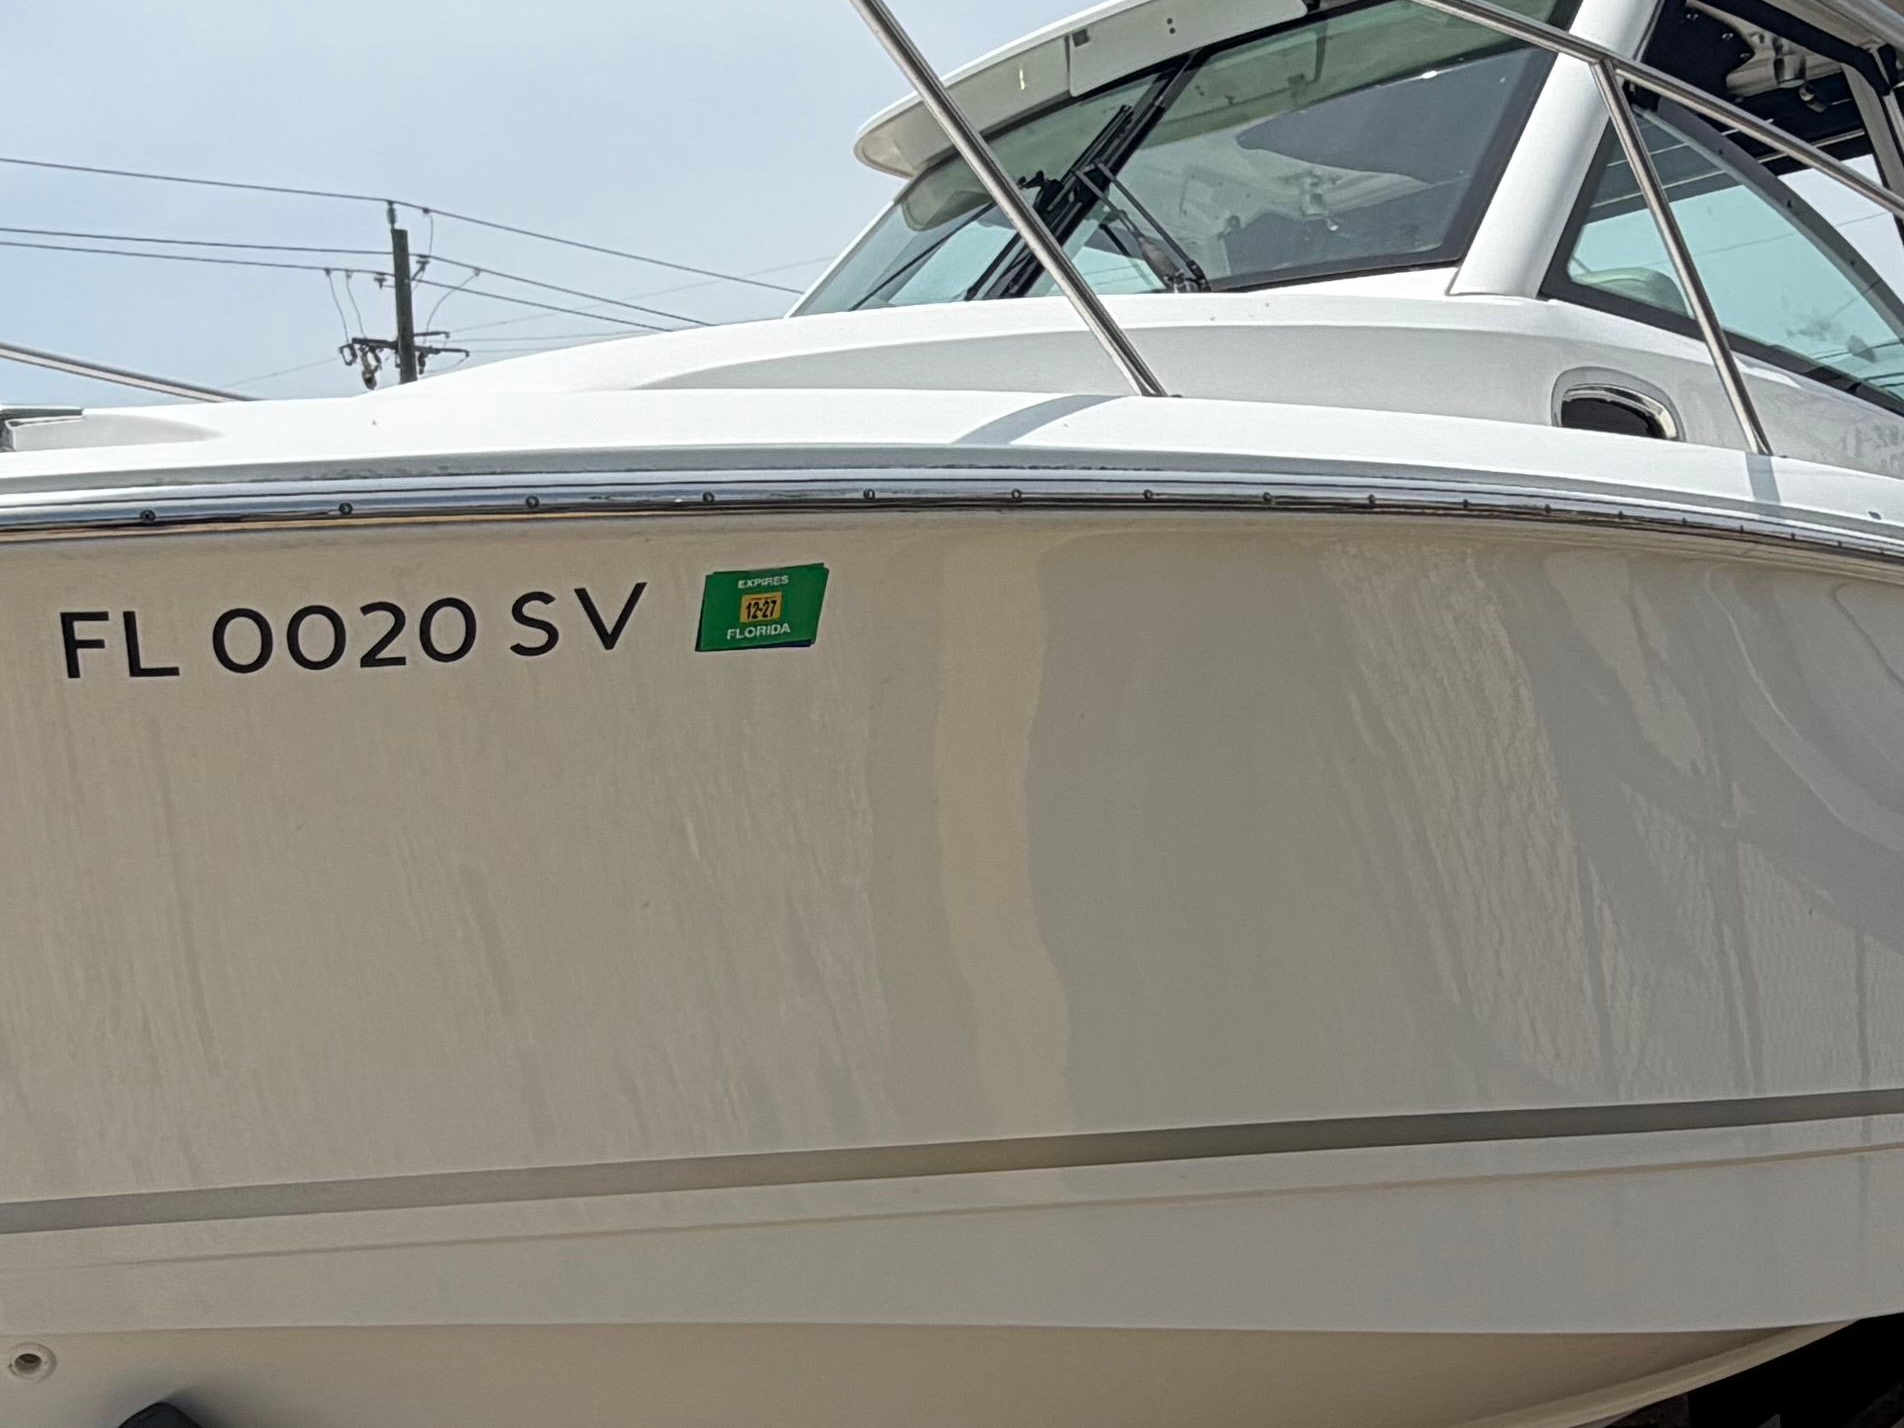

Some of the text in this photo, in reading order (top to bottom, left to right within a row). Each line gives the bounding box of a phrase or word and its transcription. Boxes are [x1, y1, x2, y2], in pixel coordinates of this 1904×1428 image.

[737, 574, 790, 589] EXPIRES
[745, 599, 778, 621] 12-27
[59, 610, 181, 679] FL
[211, 596, 478, 674] 0020
[726, 622, 791, 641] FLORIDA
